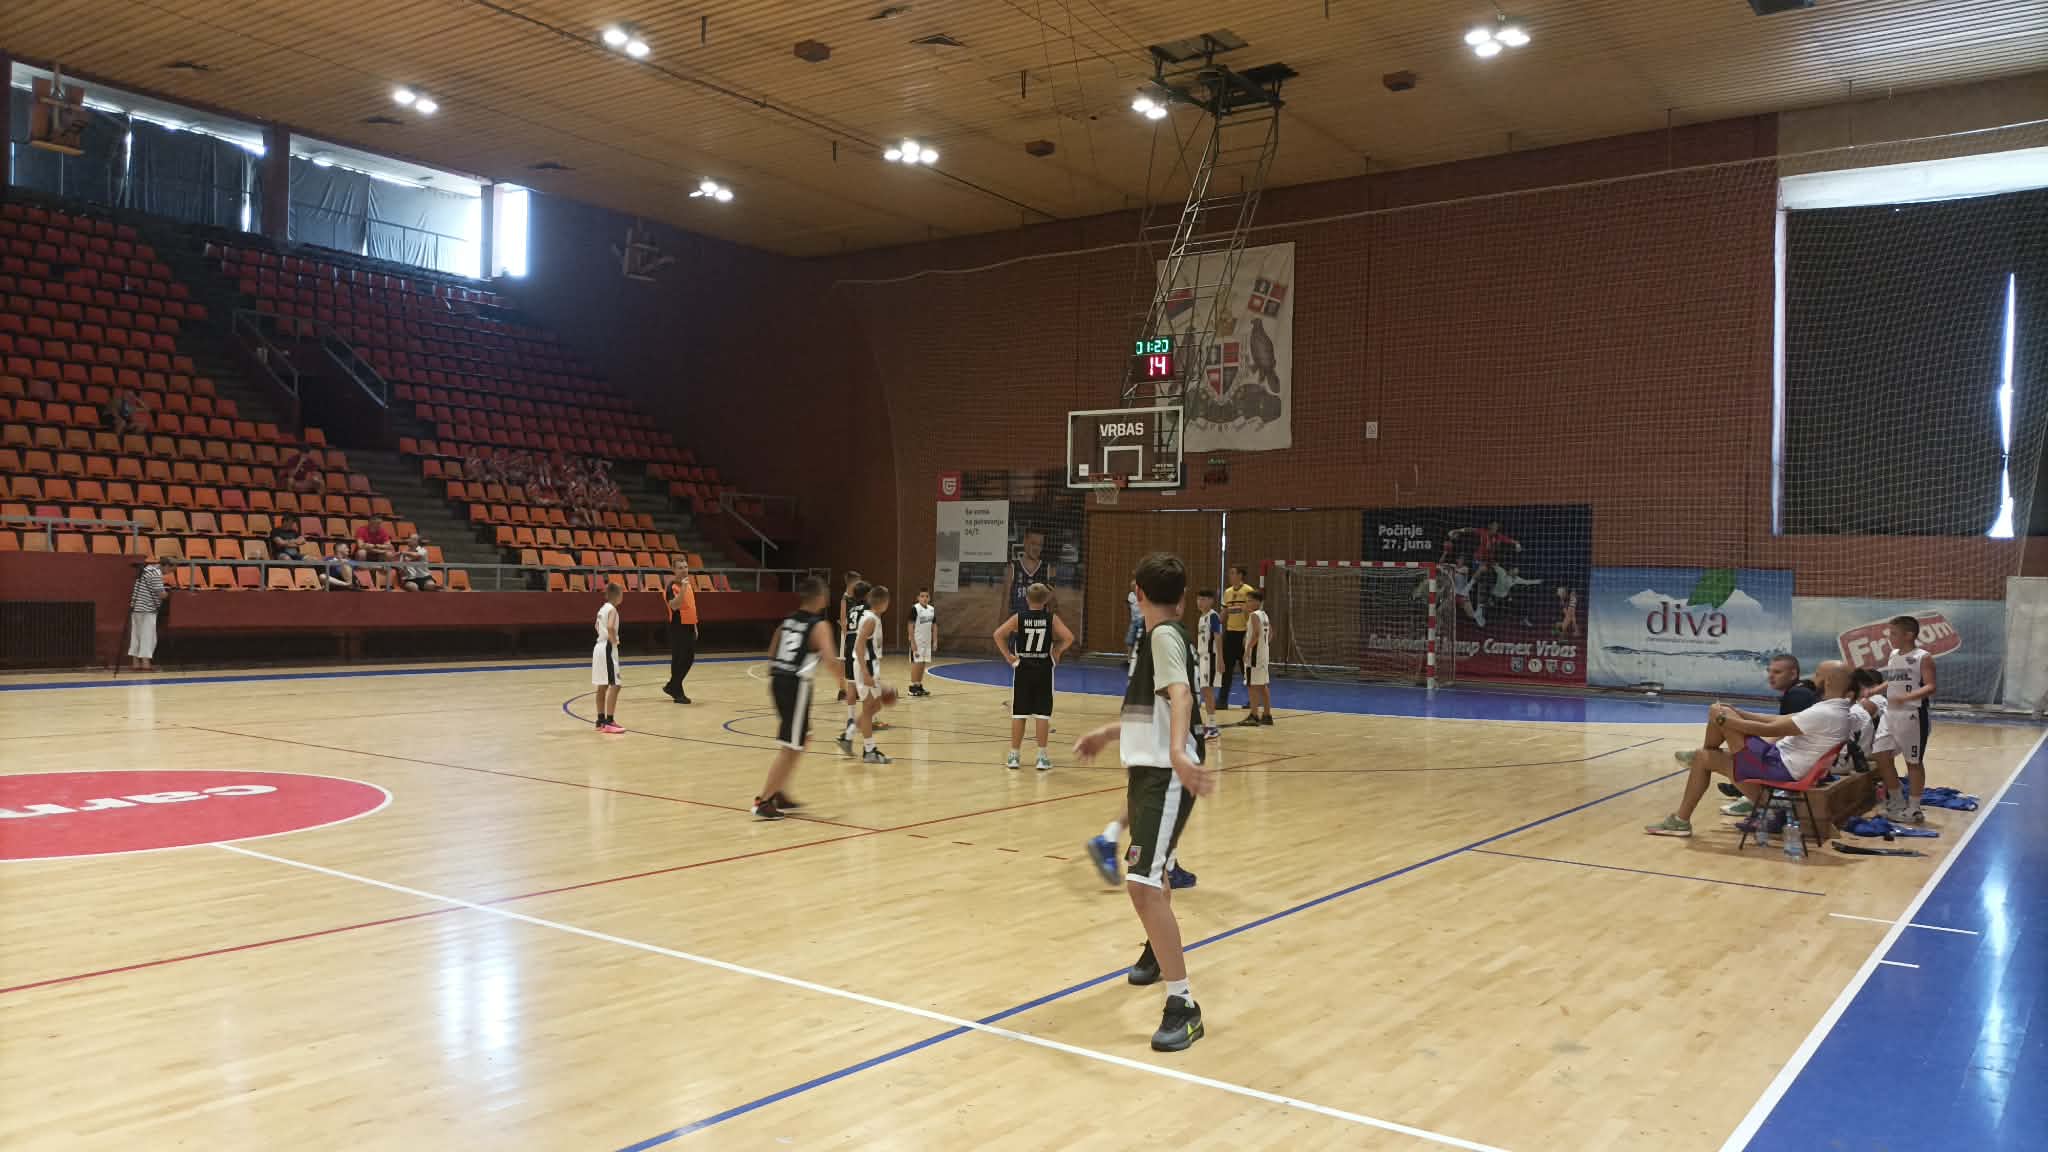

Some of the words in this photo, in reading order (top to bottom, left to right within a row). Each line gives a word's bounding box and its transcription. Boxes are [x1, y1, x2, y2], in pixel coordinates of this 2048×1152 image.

[1149, 356, 1166, 376] 14
[1100, 422, 1144, 437] VRBAS
[1378, 523, 1424, 538] Počinje
[1383, 538, 1401, 550] 27.
[1403, 538, 1432, 551] juna
[1647, 601, 1727, 638] diva
[1024, 628, 1047, 652] 77
[1536, 639, 1577, 658] Vrbas
[1848, 621, 1953, 668] Friom
